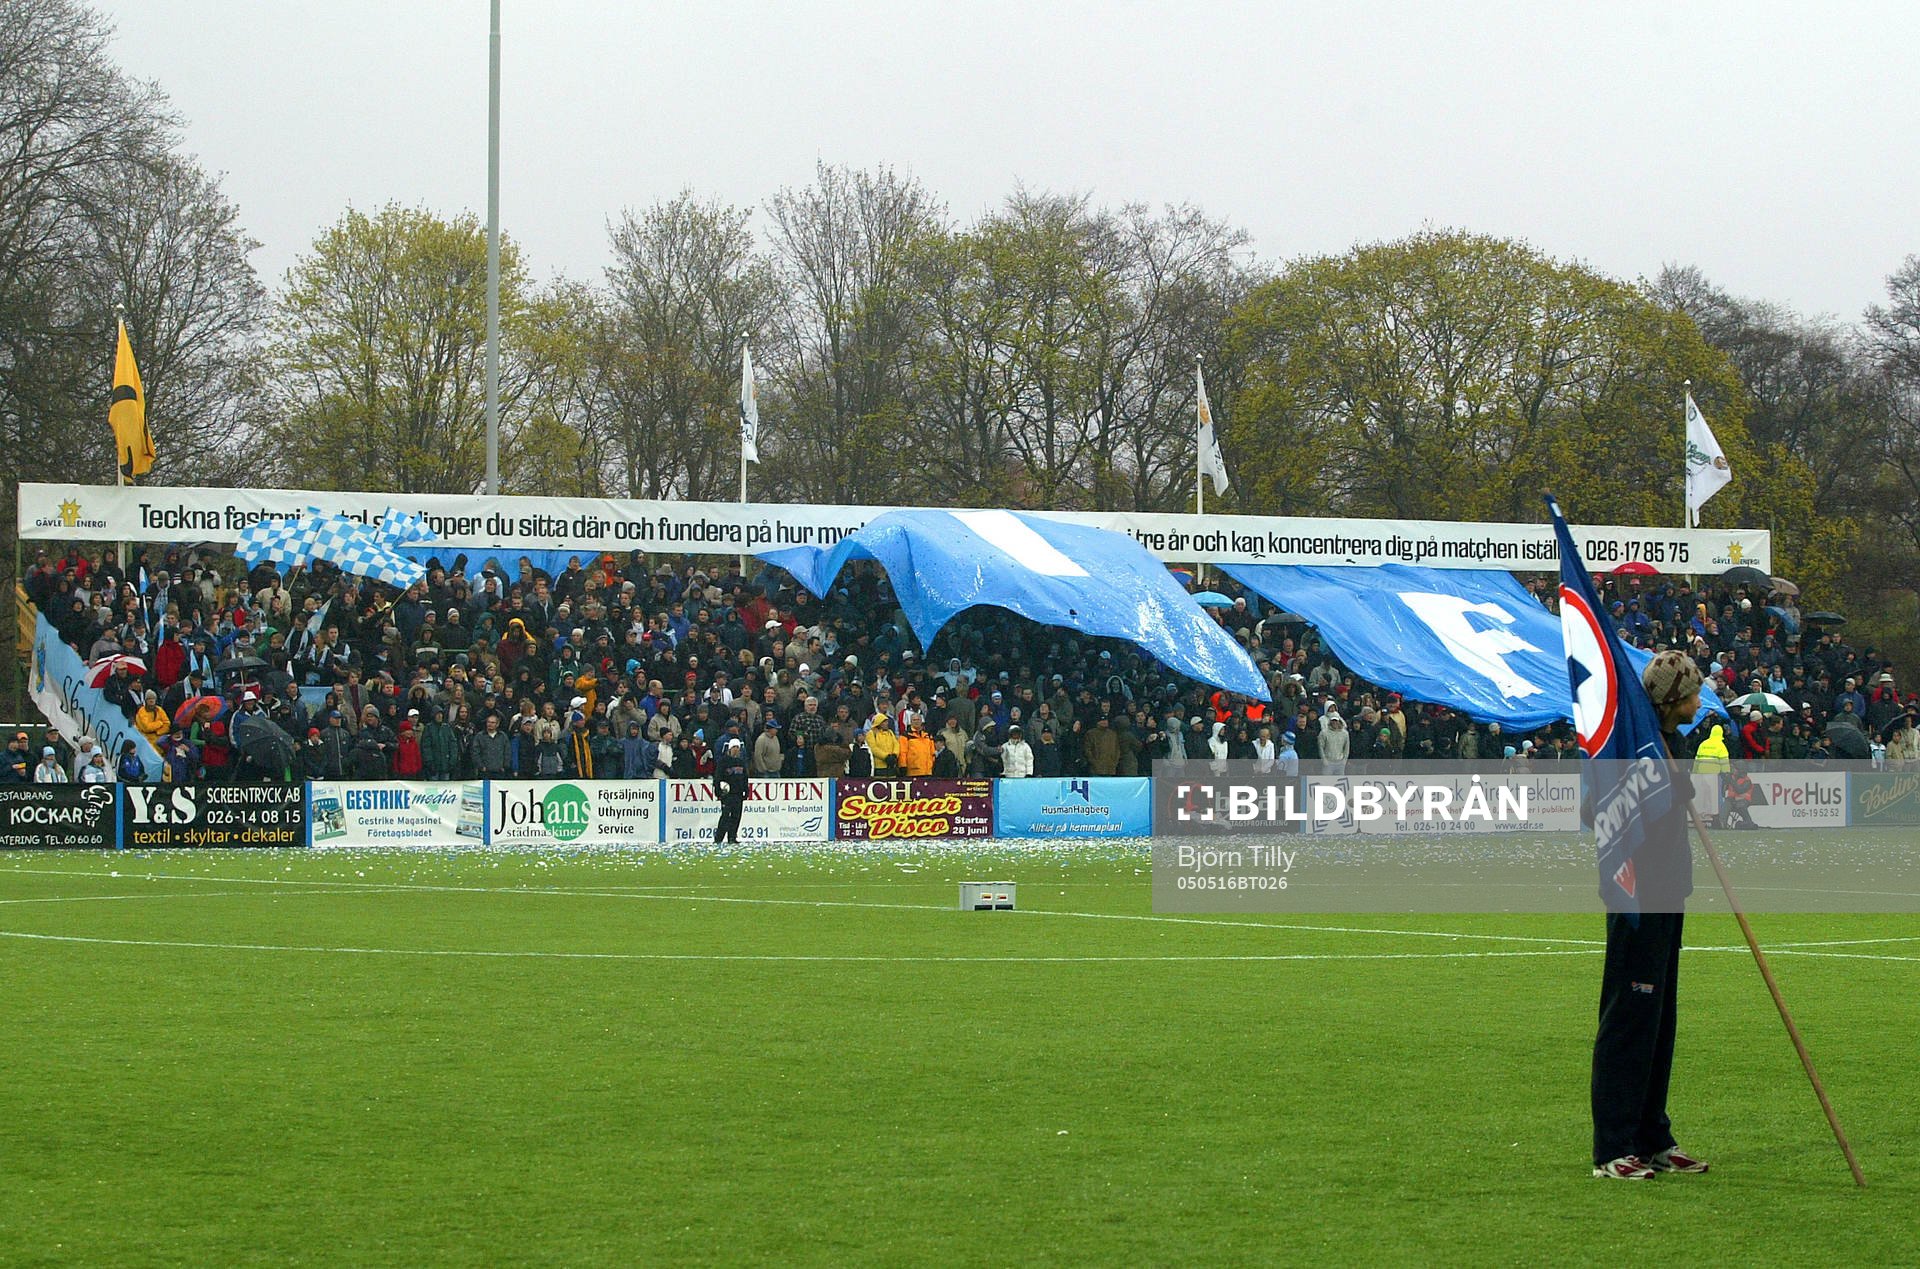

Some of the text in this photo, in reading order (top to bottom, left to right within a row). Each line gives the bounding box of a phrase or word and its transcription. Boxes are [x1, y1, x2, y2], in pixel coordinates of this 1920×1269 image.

[35, 517, 107, 529] GÄVLE ENERGI
[139, 504, 220, 530] Teckna
[486, 512, 514, 537] du
[518, 514, 568, 538] sitta
[572, 515, 611, 539] där
[614, 516, 653, 541] och
[659, 517, 742, 542] fundera
[746, 519, 772, 547] på
[776, 520, 814, 544] hur
[1168, 528, 1189, 551] år
[1193, 530, 1228, 552] och
[1231, 530, 1264, 554] kan
[1268, 531, 1382, 556] koncentrera
[1385, 534, 1414, 561] dig
[1416, 536, 1438, 563] på
[1441, 537, 1519, 561] matchen
[1643, 541, 1665, 562] 85
[1669, 542, 1689, 564] 75
[206, 786, 301, 804] SCREENTRYCK AB
[598, 788, 655, 803] Försäljning
[867, 780, 913, 802] CH
[1772, 781, 1842, 806] PreHus
[346, 788, 457, 811] GESTRIKE media
[494, 788, 592, 836] Johans
[598, 806, 649, 820] Uthyrning
[743, 804, 766, 814] Akuta
[839, 796, 960, 819] Sommar
[1041, 804, 1110, 816] HusmanHagberg
[1791, 807, 1840, 818] 026-19 52 52
[207, 809, 301, 824] 026-14 08 15
[358, 816, 395, 826] Gestrike
[954, 816, 989, 825] Startar
[506, 825, 582, 838] städmaskiner
[598, 823, 635, 835] Service
[870, 817, 948, 837] Disco
[952, 826, 965, 835] 28
[1055, 823, 1067, 836] på
[1394, 820, 1544, 832] Tel. 026-10 24 00 www.sdr.se
[133, 826, 295, 847] textil skyltar dekaler
[367, 829, 432, 838] Företagsbladet
[676, 827, 695, 840] Tel.
[741, 826, 755, 839] 32
[756, 826, 769, 838] 91
[0, 834, 40, 846] ATERING
[77, 835, 90, 845] 60
[91, 834, 103, 844] 60
